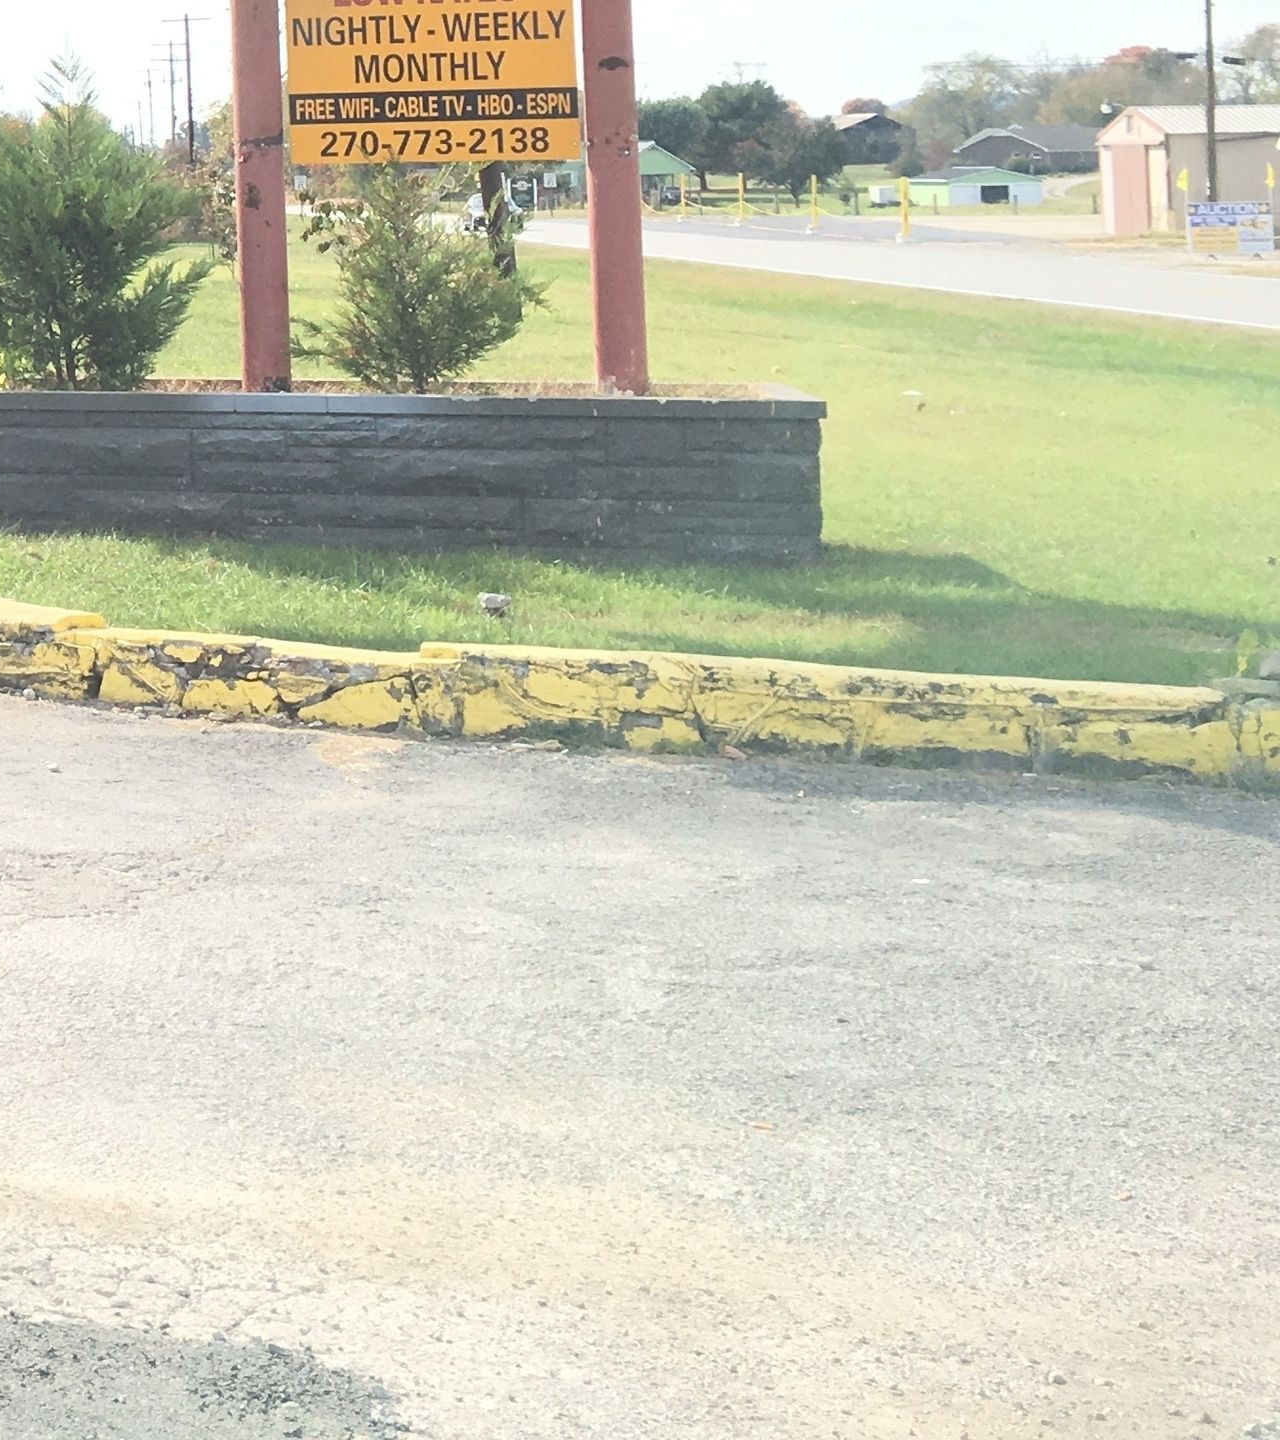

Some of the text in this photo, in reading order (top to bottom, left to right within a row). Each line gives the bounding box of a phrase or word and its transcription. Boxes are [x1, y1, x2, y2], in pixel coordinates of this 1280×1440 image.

[292, 14, 421, 46] NIGHTLY
[442, 10, 566, 42] WEEKLY
[355, 51, 506, 84] MONTHLY
[295, 98, 335, 120] FREE
[384, 95, 438, 118] CABLE
[477, 94, 513, 116] HBO
[526, 92, 571, 115] ESPN
[320, 127, 550, 157] 270-773-2138
[1197, 204, 1258, 215] AUCTION
